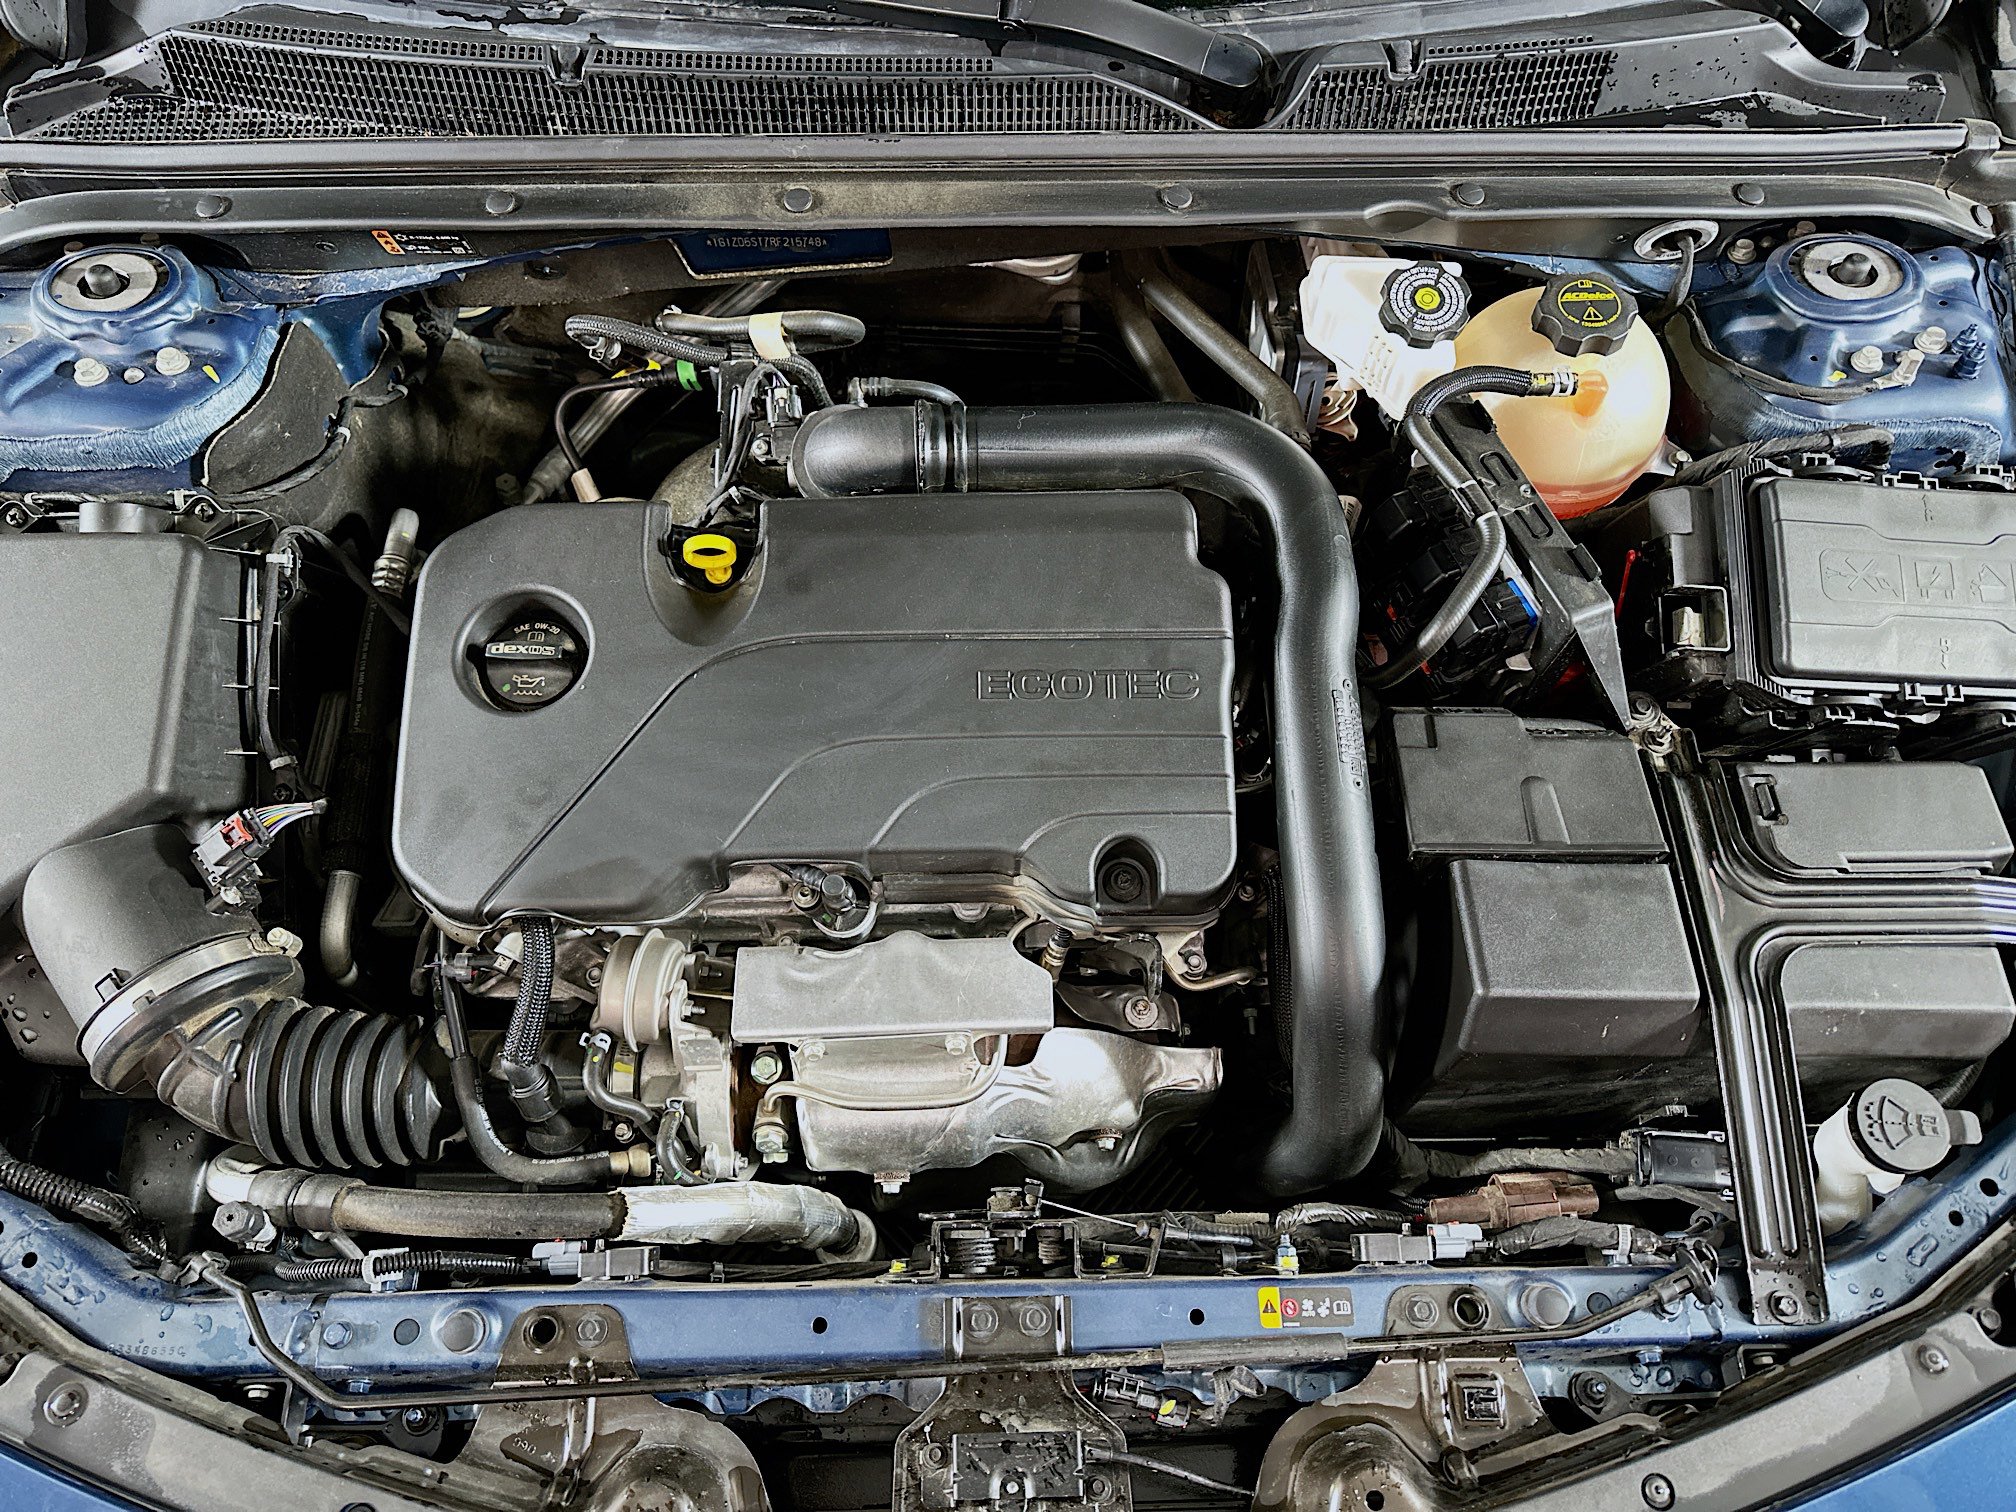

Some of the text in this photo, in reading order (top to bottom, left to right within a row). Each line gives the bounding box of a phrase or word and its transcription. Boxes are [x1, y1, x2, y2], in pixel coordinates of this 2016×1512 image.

[1561, 292, 1616, 300] ACDelco
[514, 622, 561, 635] SAE 0W-20
[490, 642, 556, 656] dexos
[977, 669, 1200, 700] ECOTEC
